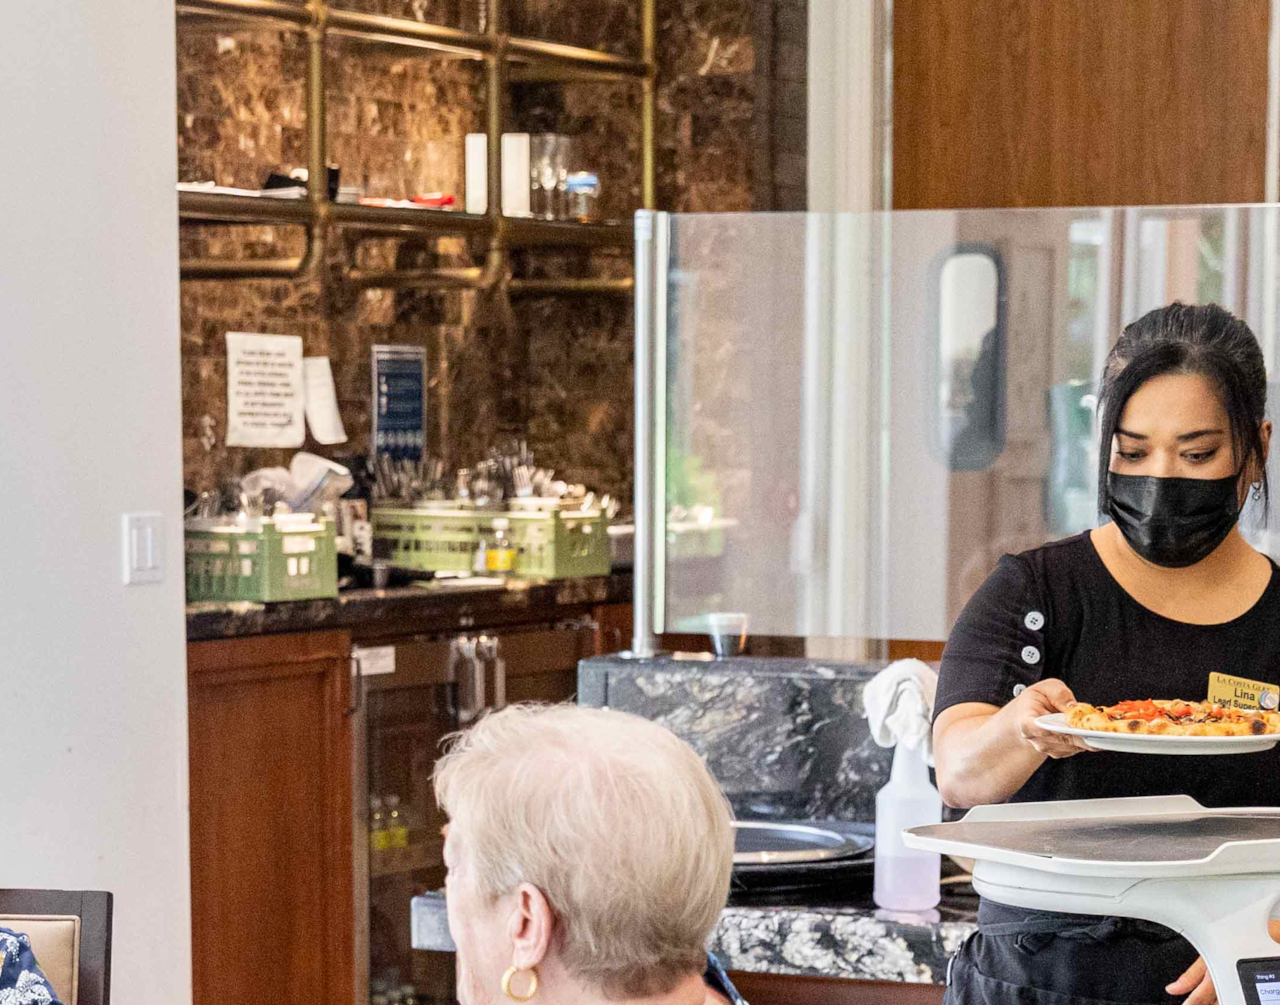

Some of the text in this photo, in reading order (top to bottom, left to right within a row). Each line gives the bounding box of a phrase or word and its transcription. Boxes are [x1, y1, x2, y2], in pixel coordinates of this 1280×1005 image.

[1228, 678, 1250, 689] COSTA
[1234, 688, 1255, 701] Lina
[1213, 695, 1232, 707] Lead
[1233, 699, 1261, 710] Superv
